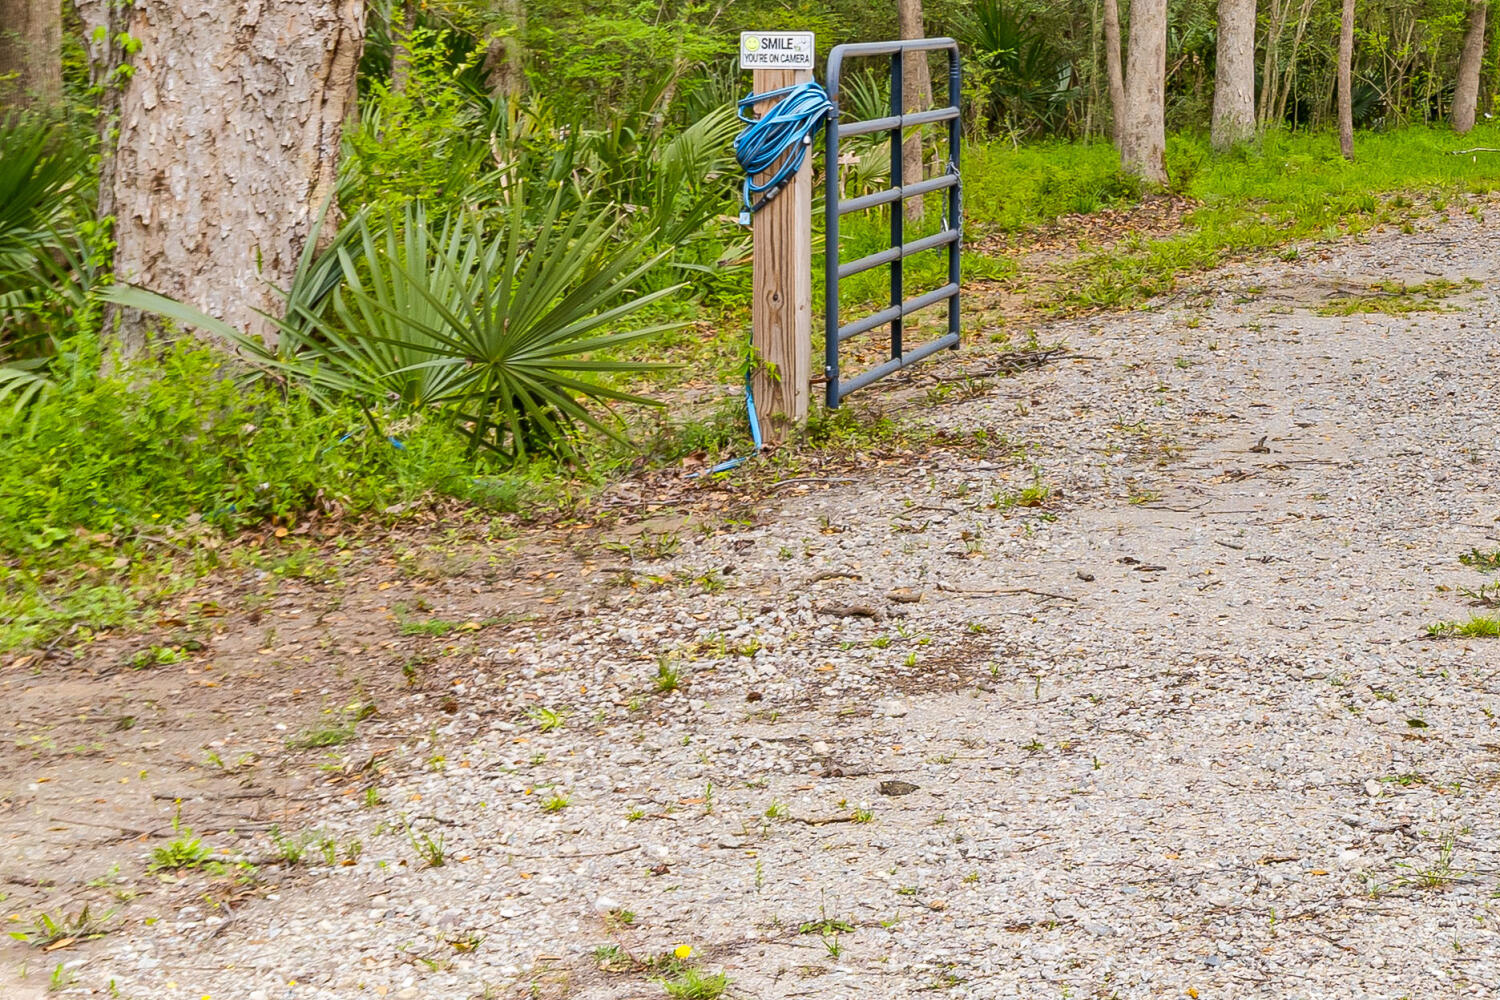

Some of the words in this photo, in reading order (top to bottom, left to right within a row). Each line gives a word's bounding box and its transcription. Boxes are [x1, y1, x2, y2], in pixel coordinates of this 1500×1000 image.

[761, 38, 793, 50] SMILE
[744, 54, 768, 63] YOU'RE
[769, 54, 779, 63] ON
[781, 54, 809, 63] CAMERA
